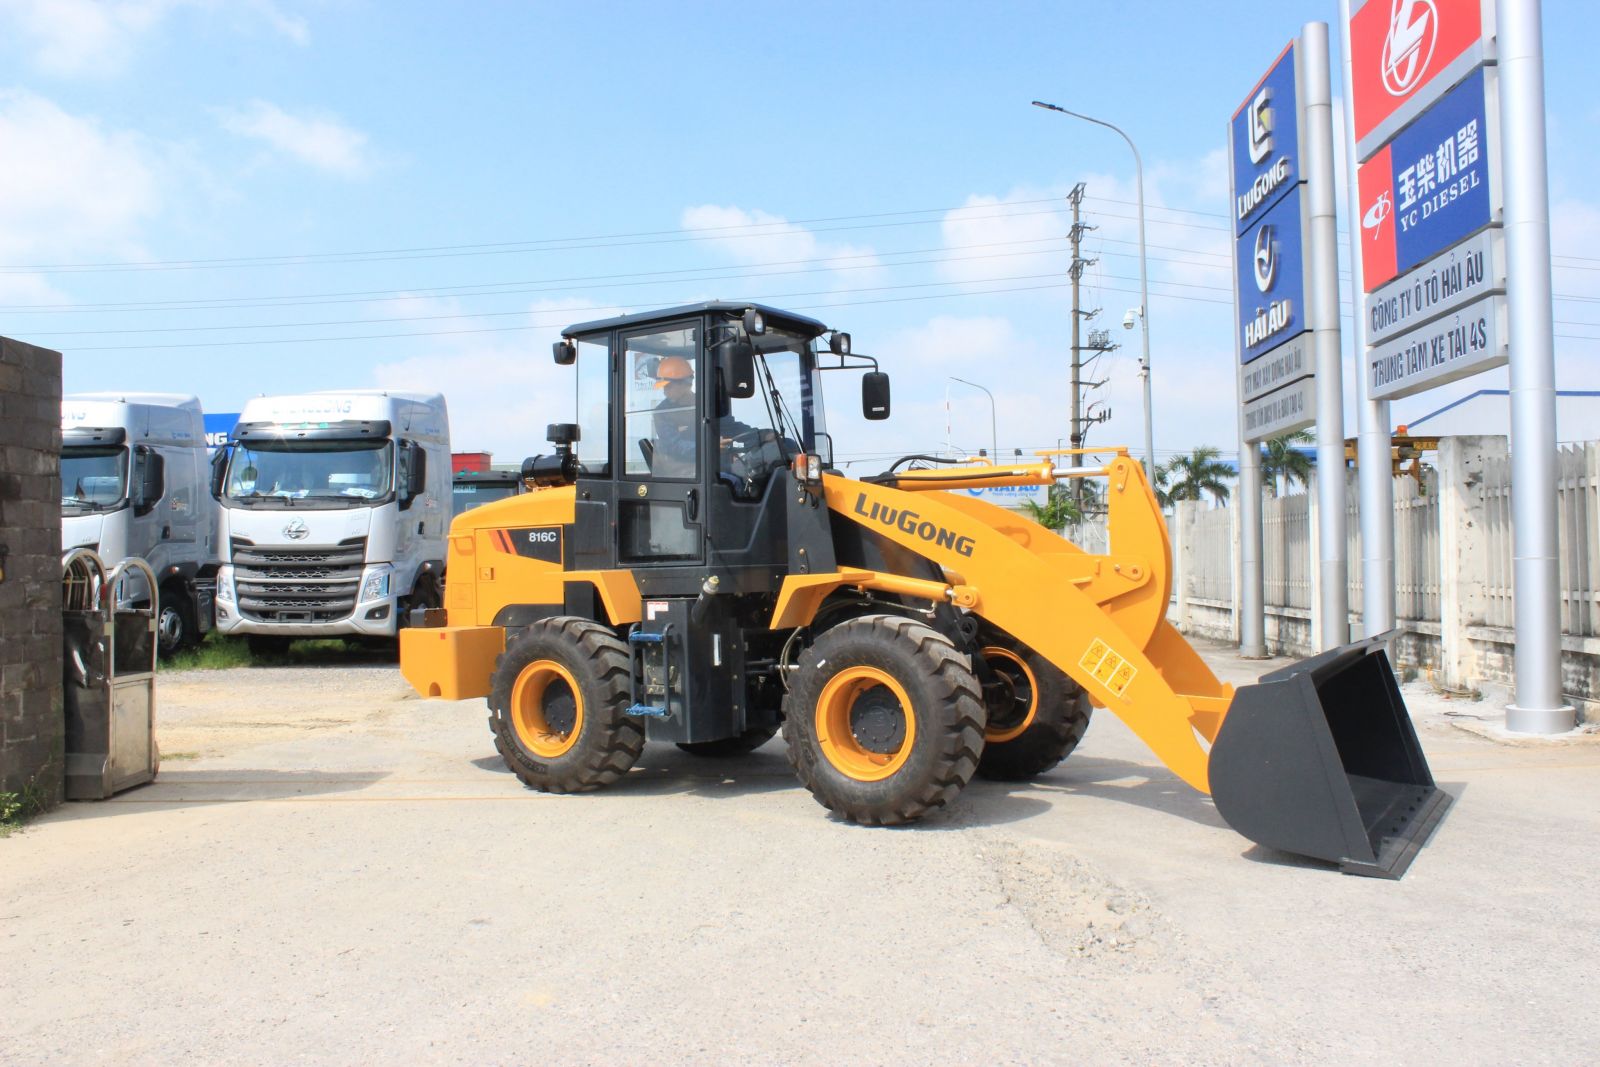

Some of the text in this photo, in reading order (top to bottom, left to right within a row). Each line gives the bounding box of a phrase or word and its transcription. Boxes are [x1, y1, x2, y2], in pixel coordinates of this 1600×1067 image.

[1398, 119, 1478, 211] 玉柴机器
[1401, 170, 1480, 232] YC DIESEL
[1245, 300, 1289, 348] HẢI ÂU
[1371, 250, 1484, 333] CÔNG TY Ô TÔ HẢI ÂU
[1372, 315, 1487, 387] TRUNG TÂM XE TẢI 4S
[529, 531, 556, 542] 816C
